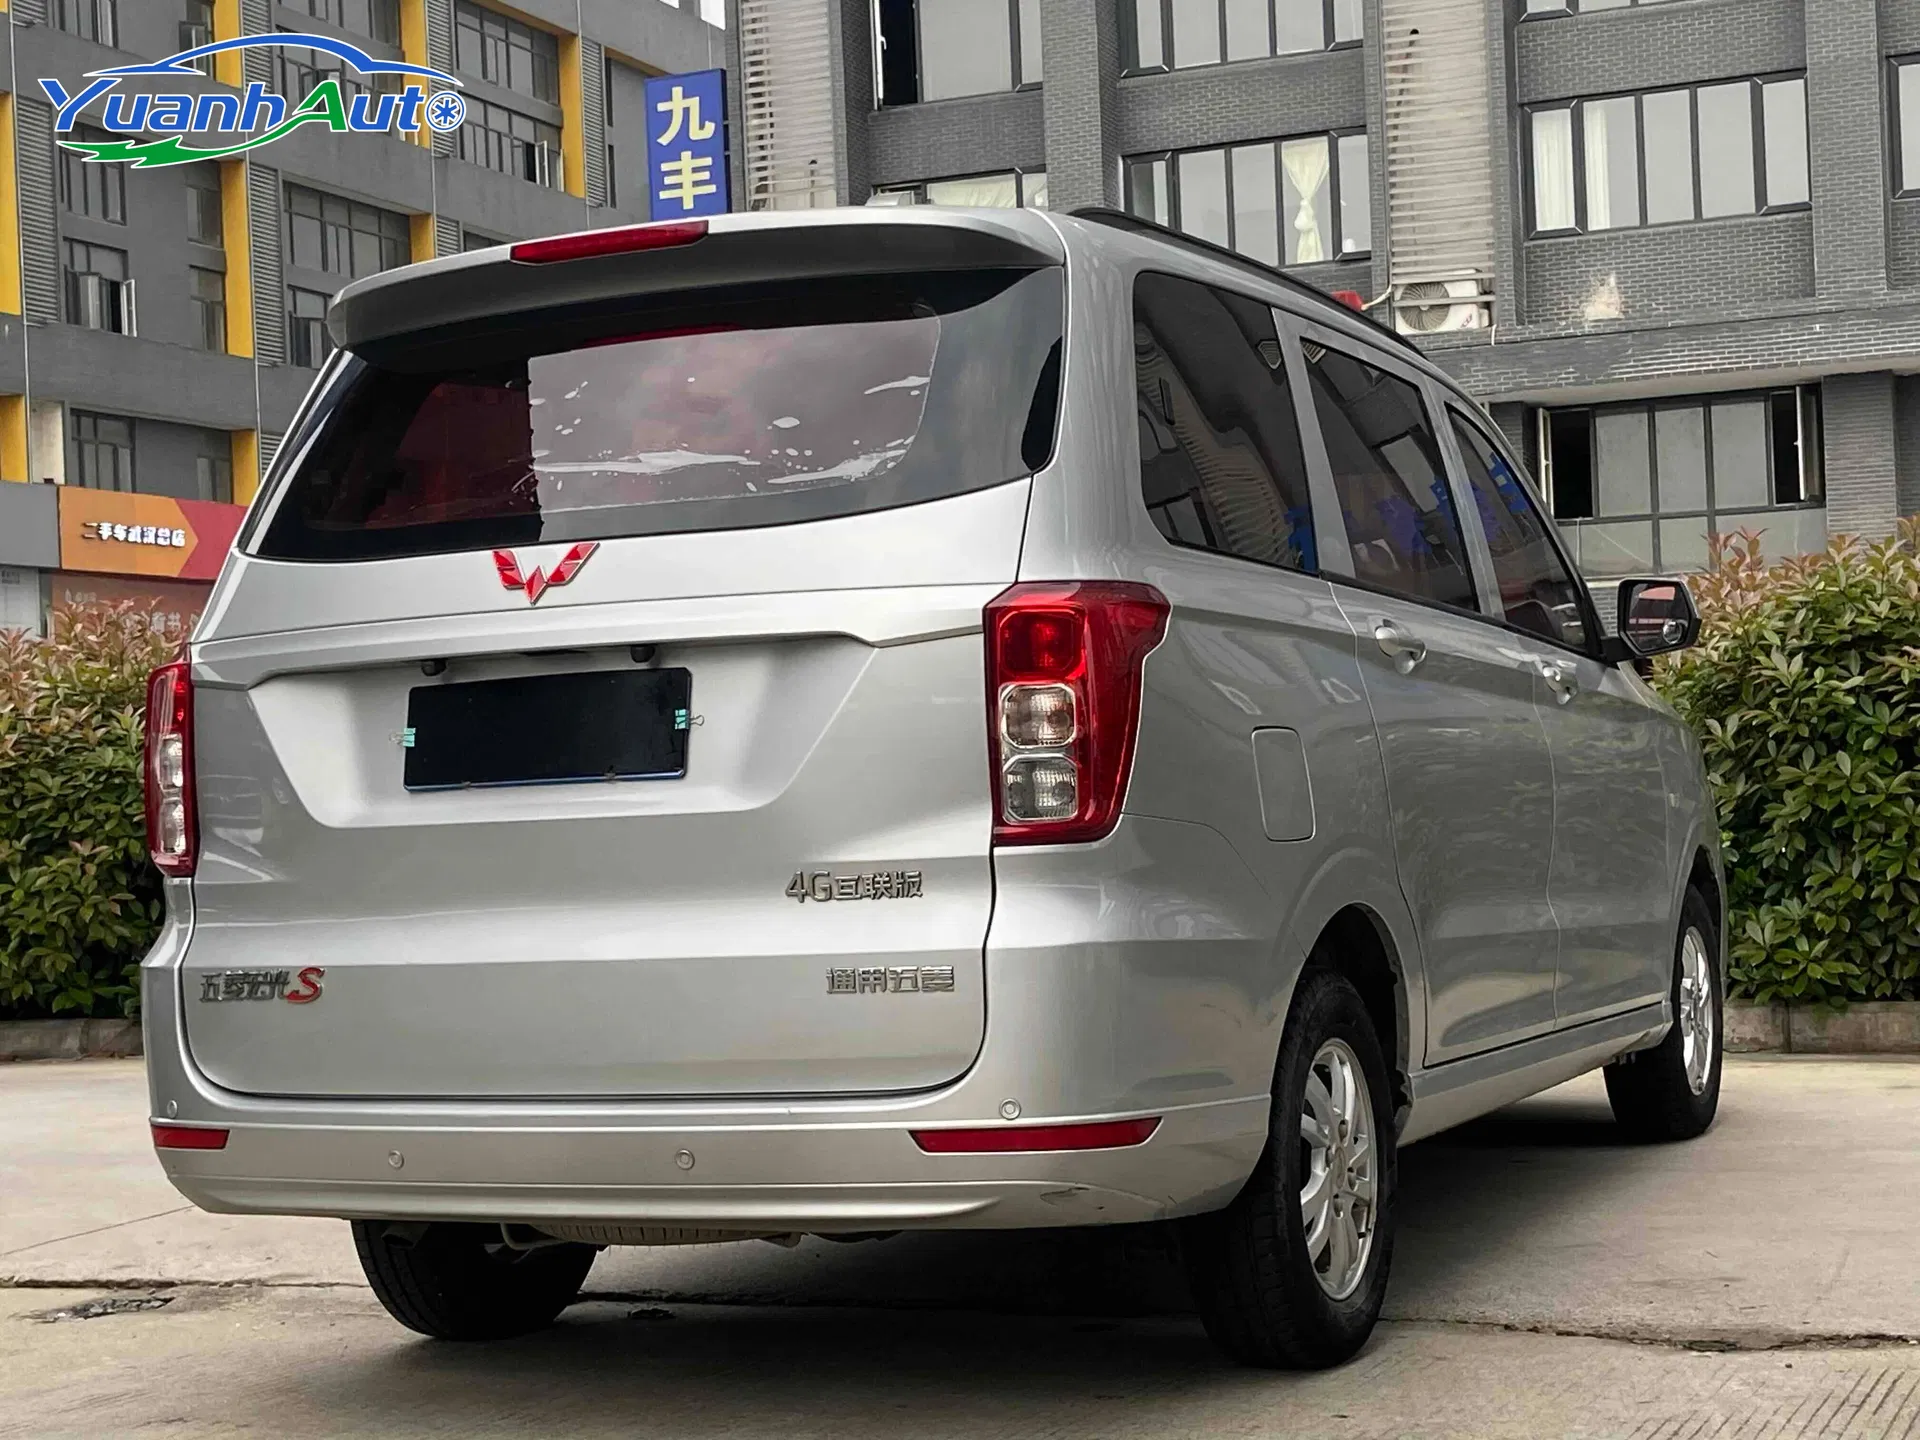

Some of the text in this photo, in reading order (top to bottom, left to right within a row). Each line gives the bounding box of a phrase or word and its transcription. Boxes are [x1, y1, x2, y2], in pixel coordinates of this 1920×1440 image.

[656, 85, 717, 210] 九丰
[785, 869, 924, 903] 4G互联版
